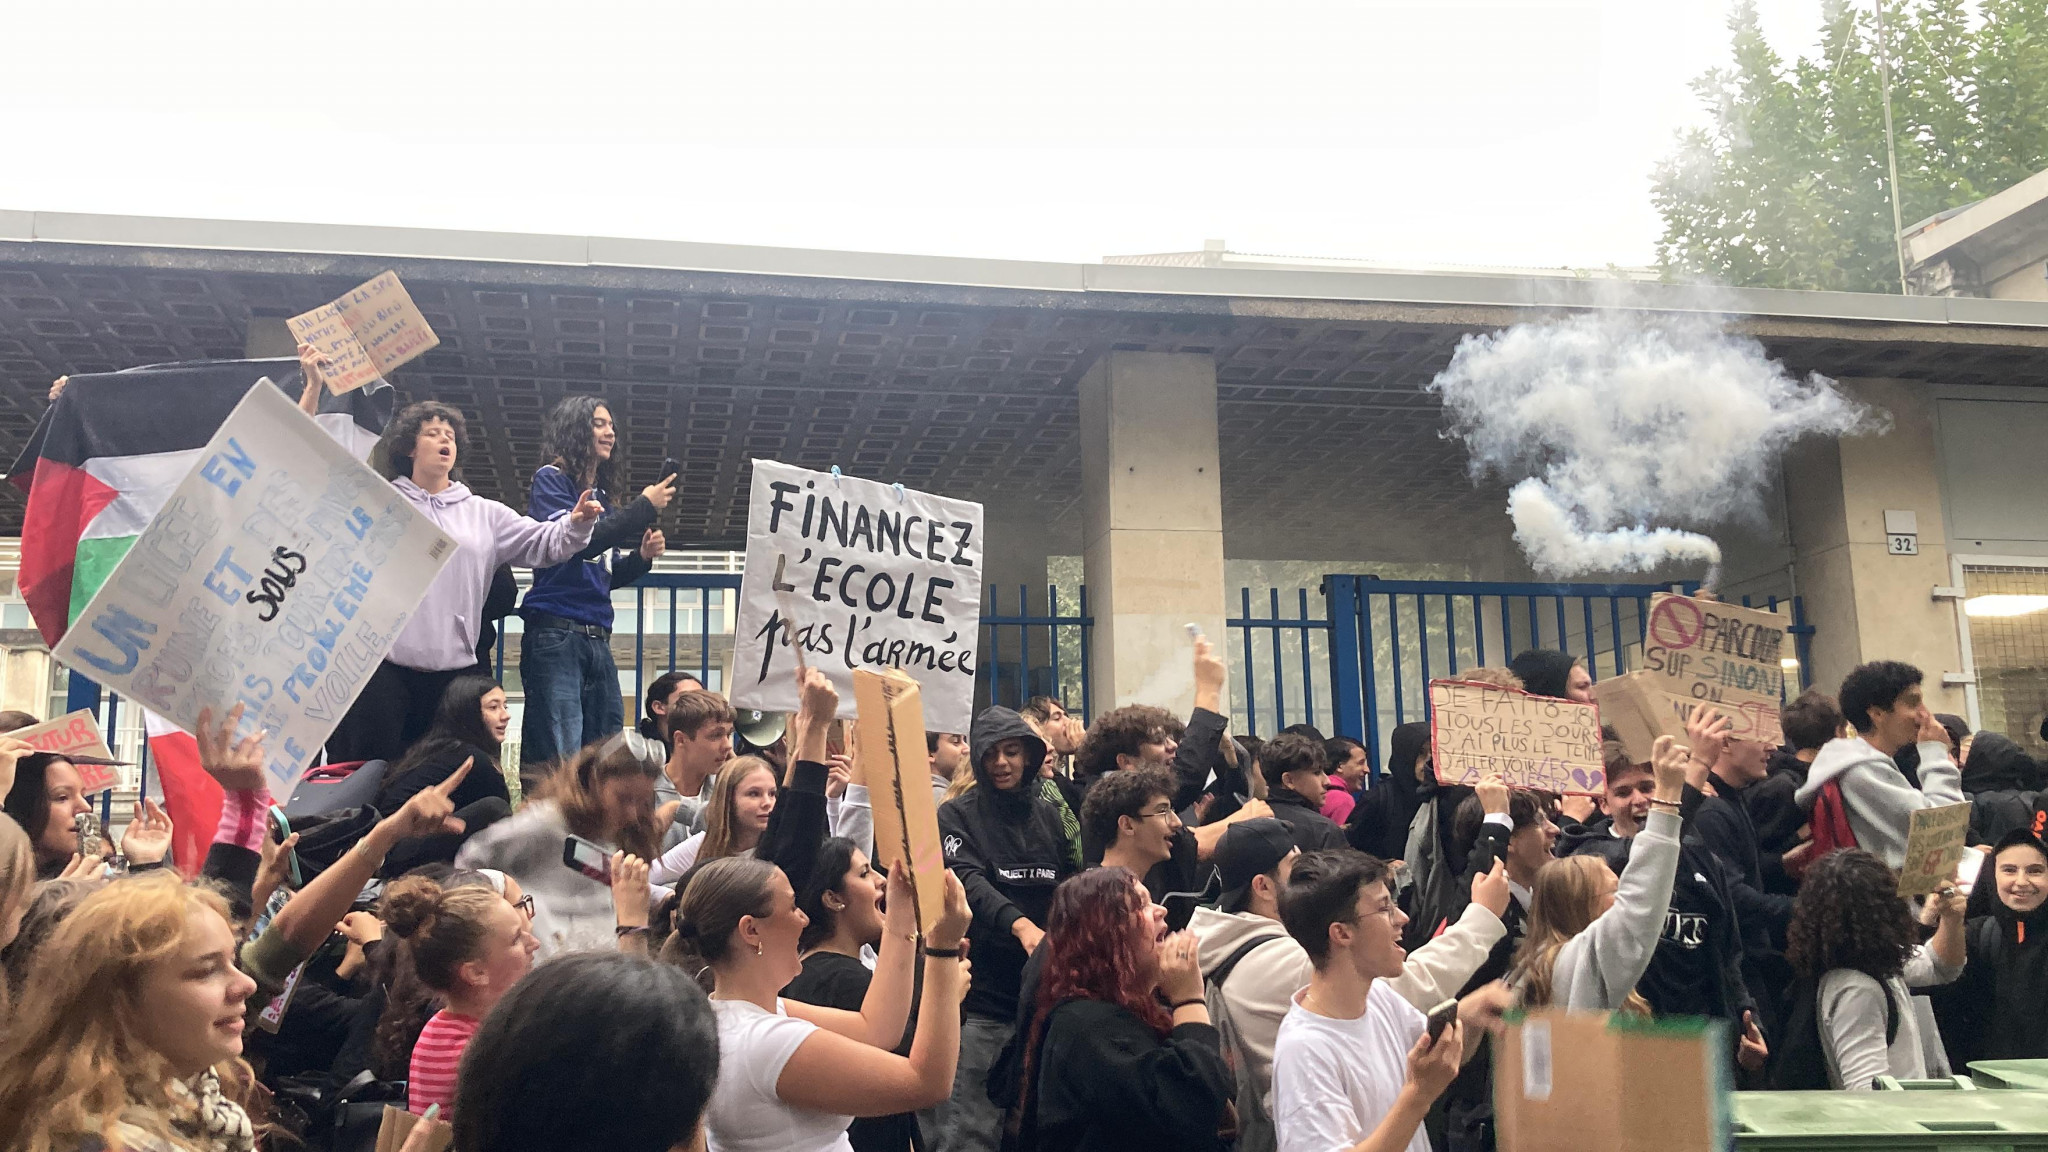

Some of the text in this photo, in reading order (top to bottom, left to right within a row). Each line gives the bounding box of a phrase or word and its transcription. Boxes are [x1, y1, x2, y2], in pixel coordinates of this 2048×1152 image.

[352, 291, 371, 304] LA
[344, 506, 374, 541] LE
[73, 604, 158, 676] UN
[200, 437, 258, 498] EN
[1894, 537, 1912, 552] 32
[203, 546, 254, 607] ET
[772, 548, 954, 624] L'ECOLE
[755, 609, 834, 685] pas
[1646, 646, 1693, 680] SUP
[1432, 685, 1468, 707] JE
[1691, 682, 1724, 704] ON
[1437, 708, 1600, 745] TOUS LES JOURS
[1492, 733, 1528, 752] PLUS
[1534, 740, 1552, 754] LE
[269, 737, 307, 784] LE
[1502, 755, 1536, 772] VOIR
[1538, 757, 1572, 781] LES
[1029, 868, 1035, 879] X
[1036, 868, 1056, 880] PARIS
